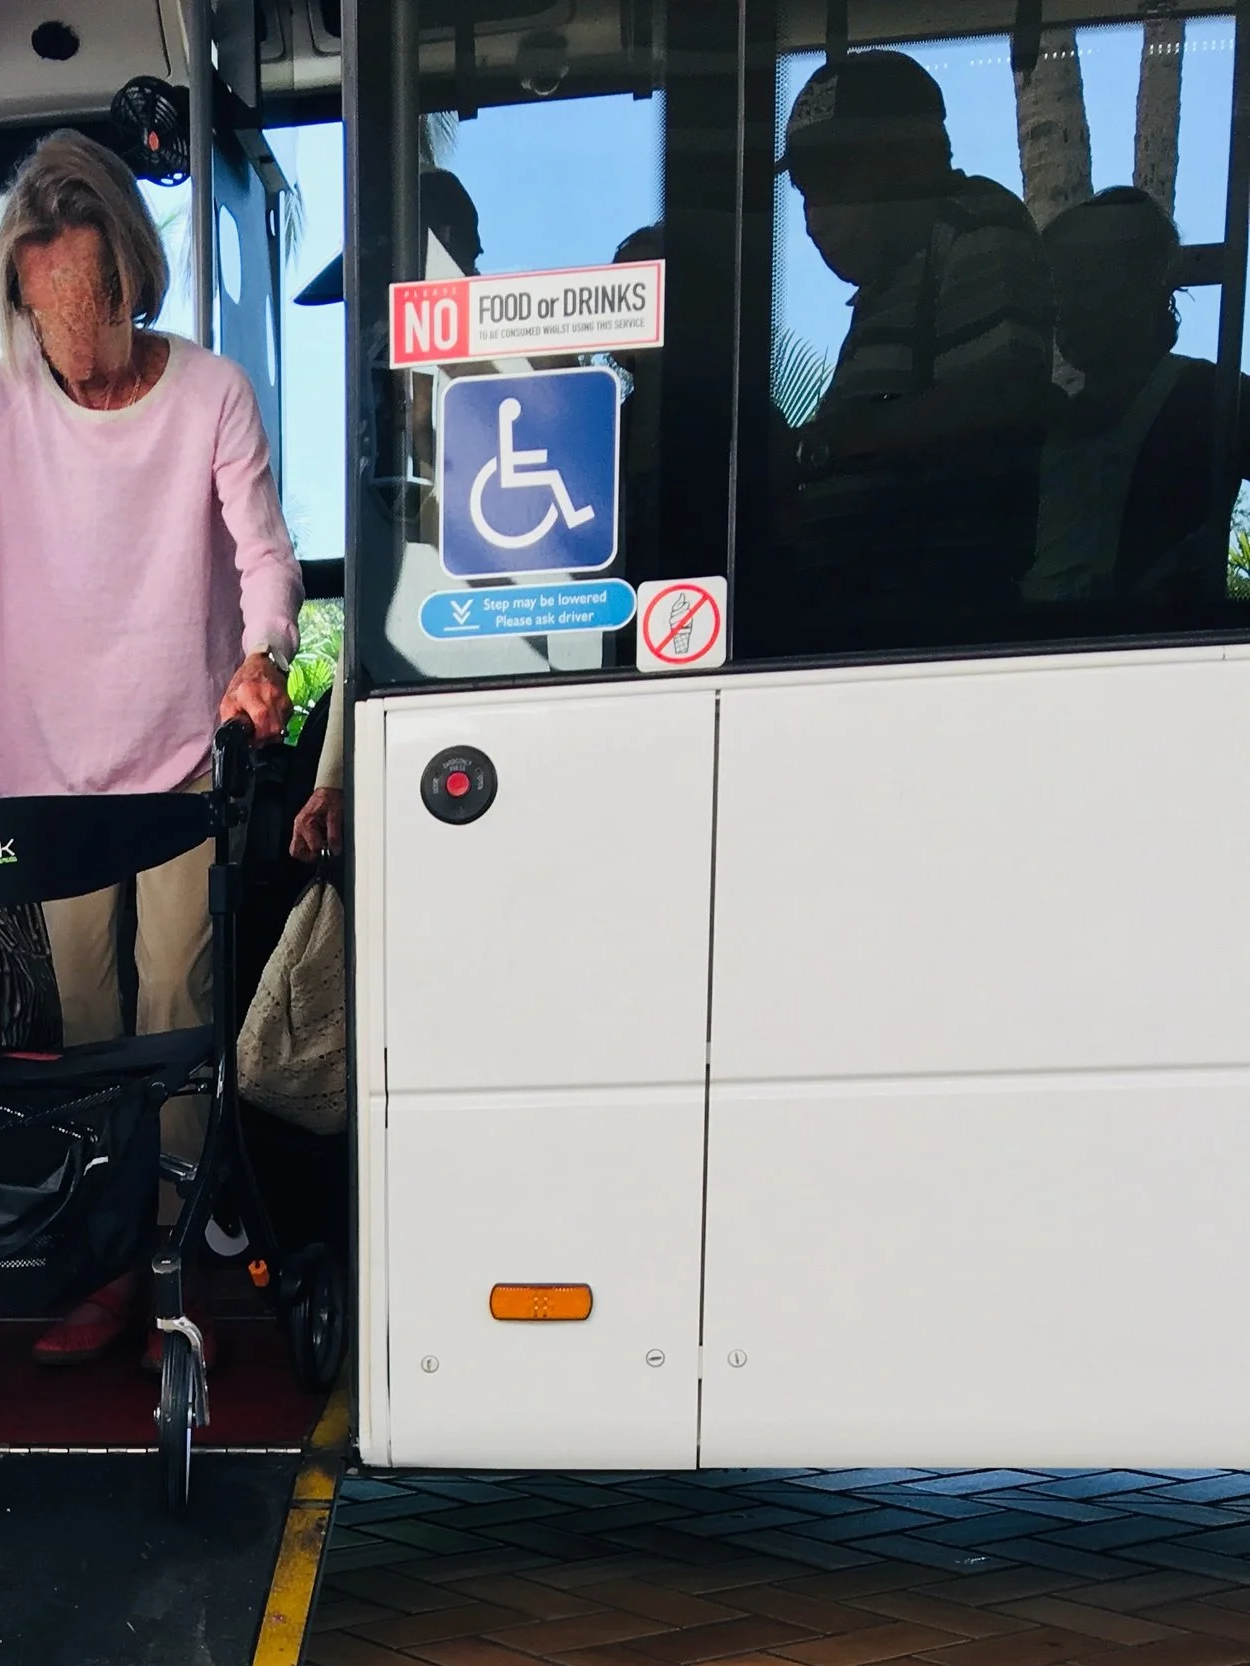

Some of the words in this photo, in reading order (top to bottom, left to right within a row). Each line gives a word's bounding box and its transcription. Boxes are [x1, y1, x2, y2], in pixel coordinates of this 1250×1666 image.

[404, 286, 458, 299] PLEASE
[479, 292, 532, 325] FOOD
[537, 297, 560, 319] or
[563, 282, 646, 318] DRINKS
[405, 298, 458, 354] NO
[479, 329, 488, 341] TO
[490, 328, 499, 340] BE
[501, 327, 541, 339] CONSUMED
[543, 322, 570, 335] WHILST
[572, 320, 595, 333] USING
[596, 319, 612, 331] THIS
[614, 317, 646, 330] SERVICE
[483, 598, 510, 613] Step
[513, 598, 537, 611] may
[540, 594, 555, 607] be
[558, 589, 607, 606] lowered
[495, 612, 533, 628] Please
[535, 612, 555, 625] ask
[558, 610, 595, 624] driver
